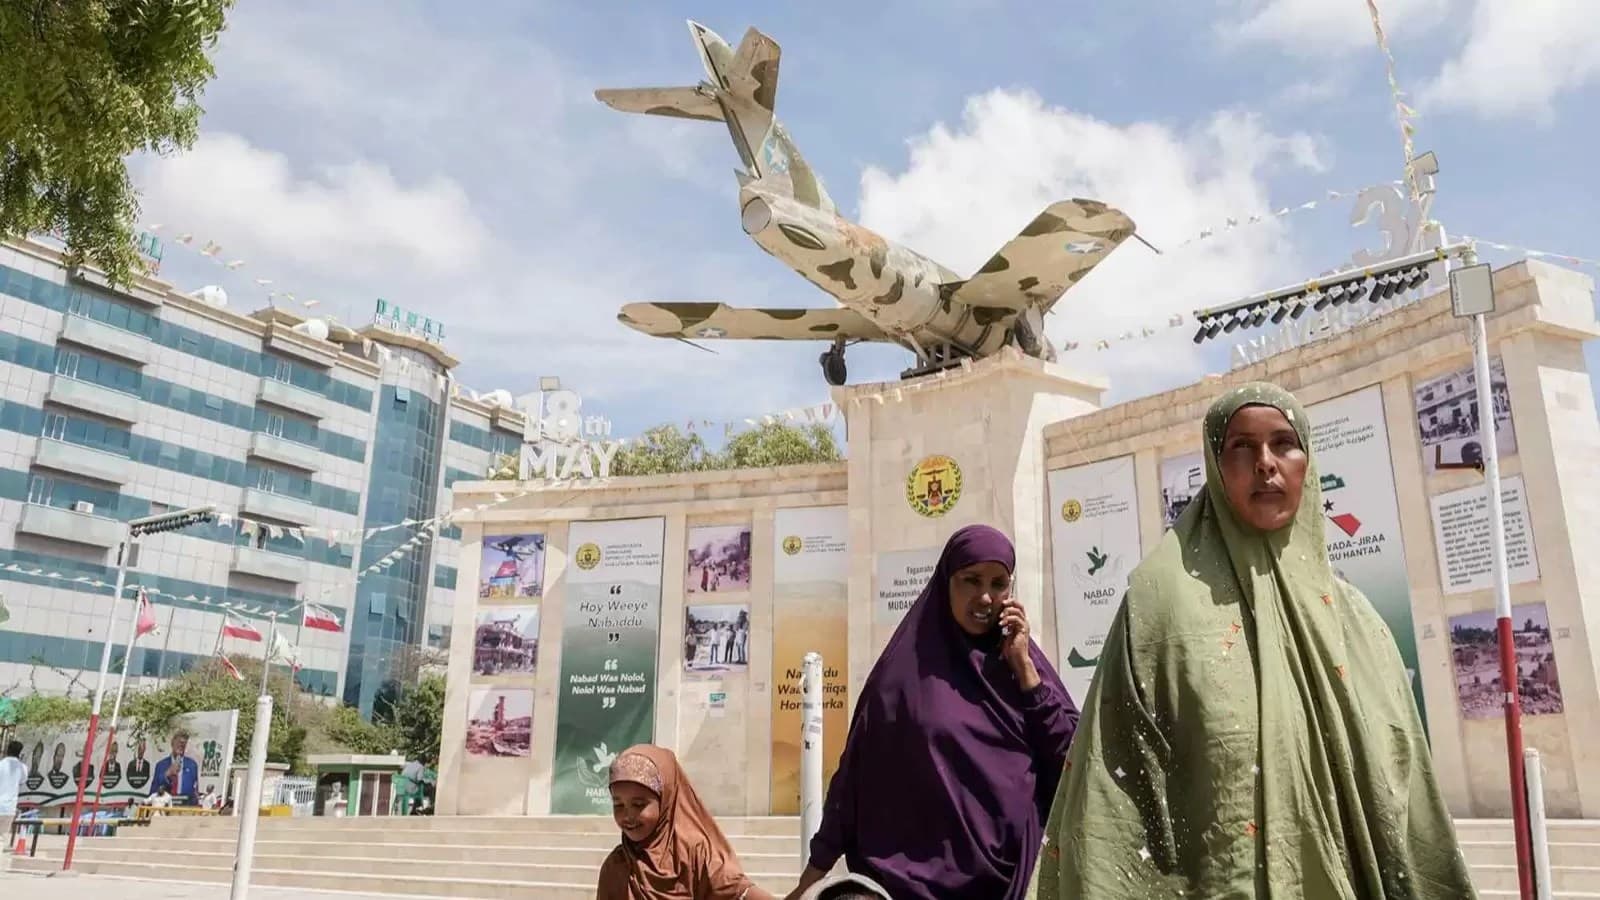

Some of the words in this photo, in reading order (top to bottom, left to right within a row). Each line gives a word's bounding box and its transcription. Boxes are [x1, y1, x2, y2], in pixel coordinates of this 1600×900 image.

[519, 441, 619, 480] MAY
[1343, 545, 1381, 559] HANTAA
[1084, 587, 1116, 600] NABAD
[888, 600, 914, 610] MUDAN
[786, 667, 838, 680] Nadu
[780, 698, 844, 711] Horrka
[202, 758, 223, 771] MAY
